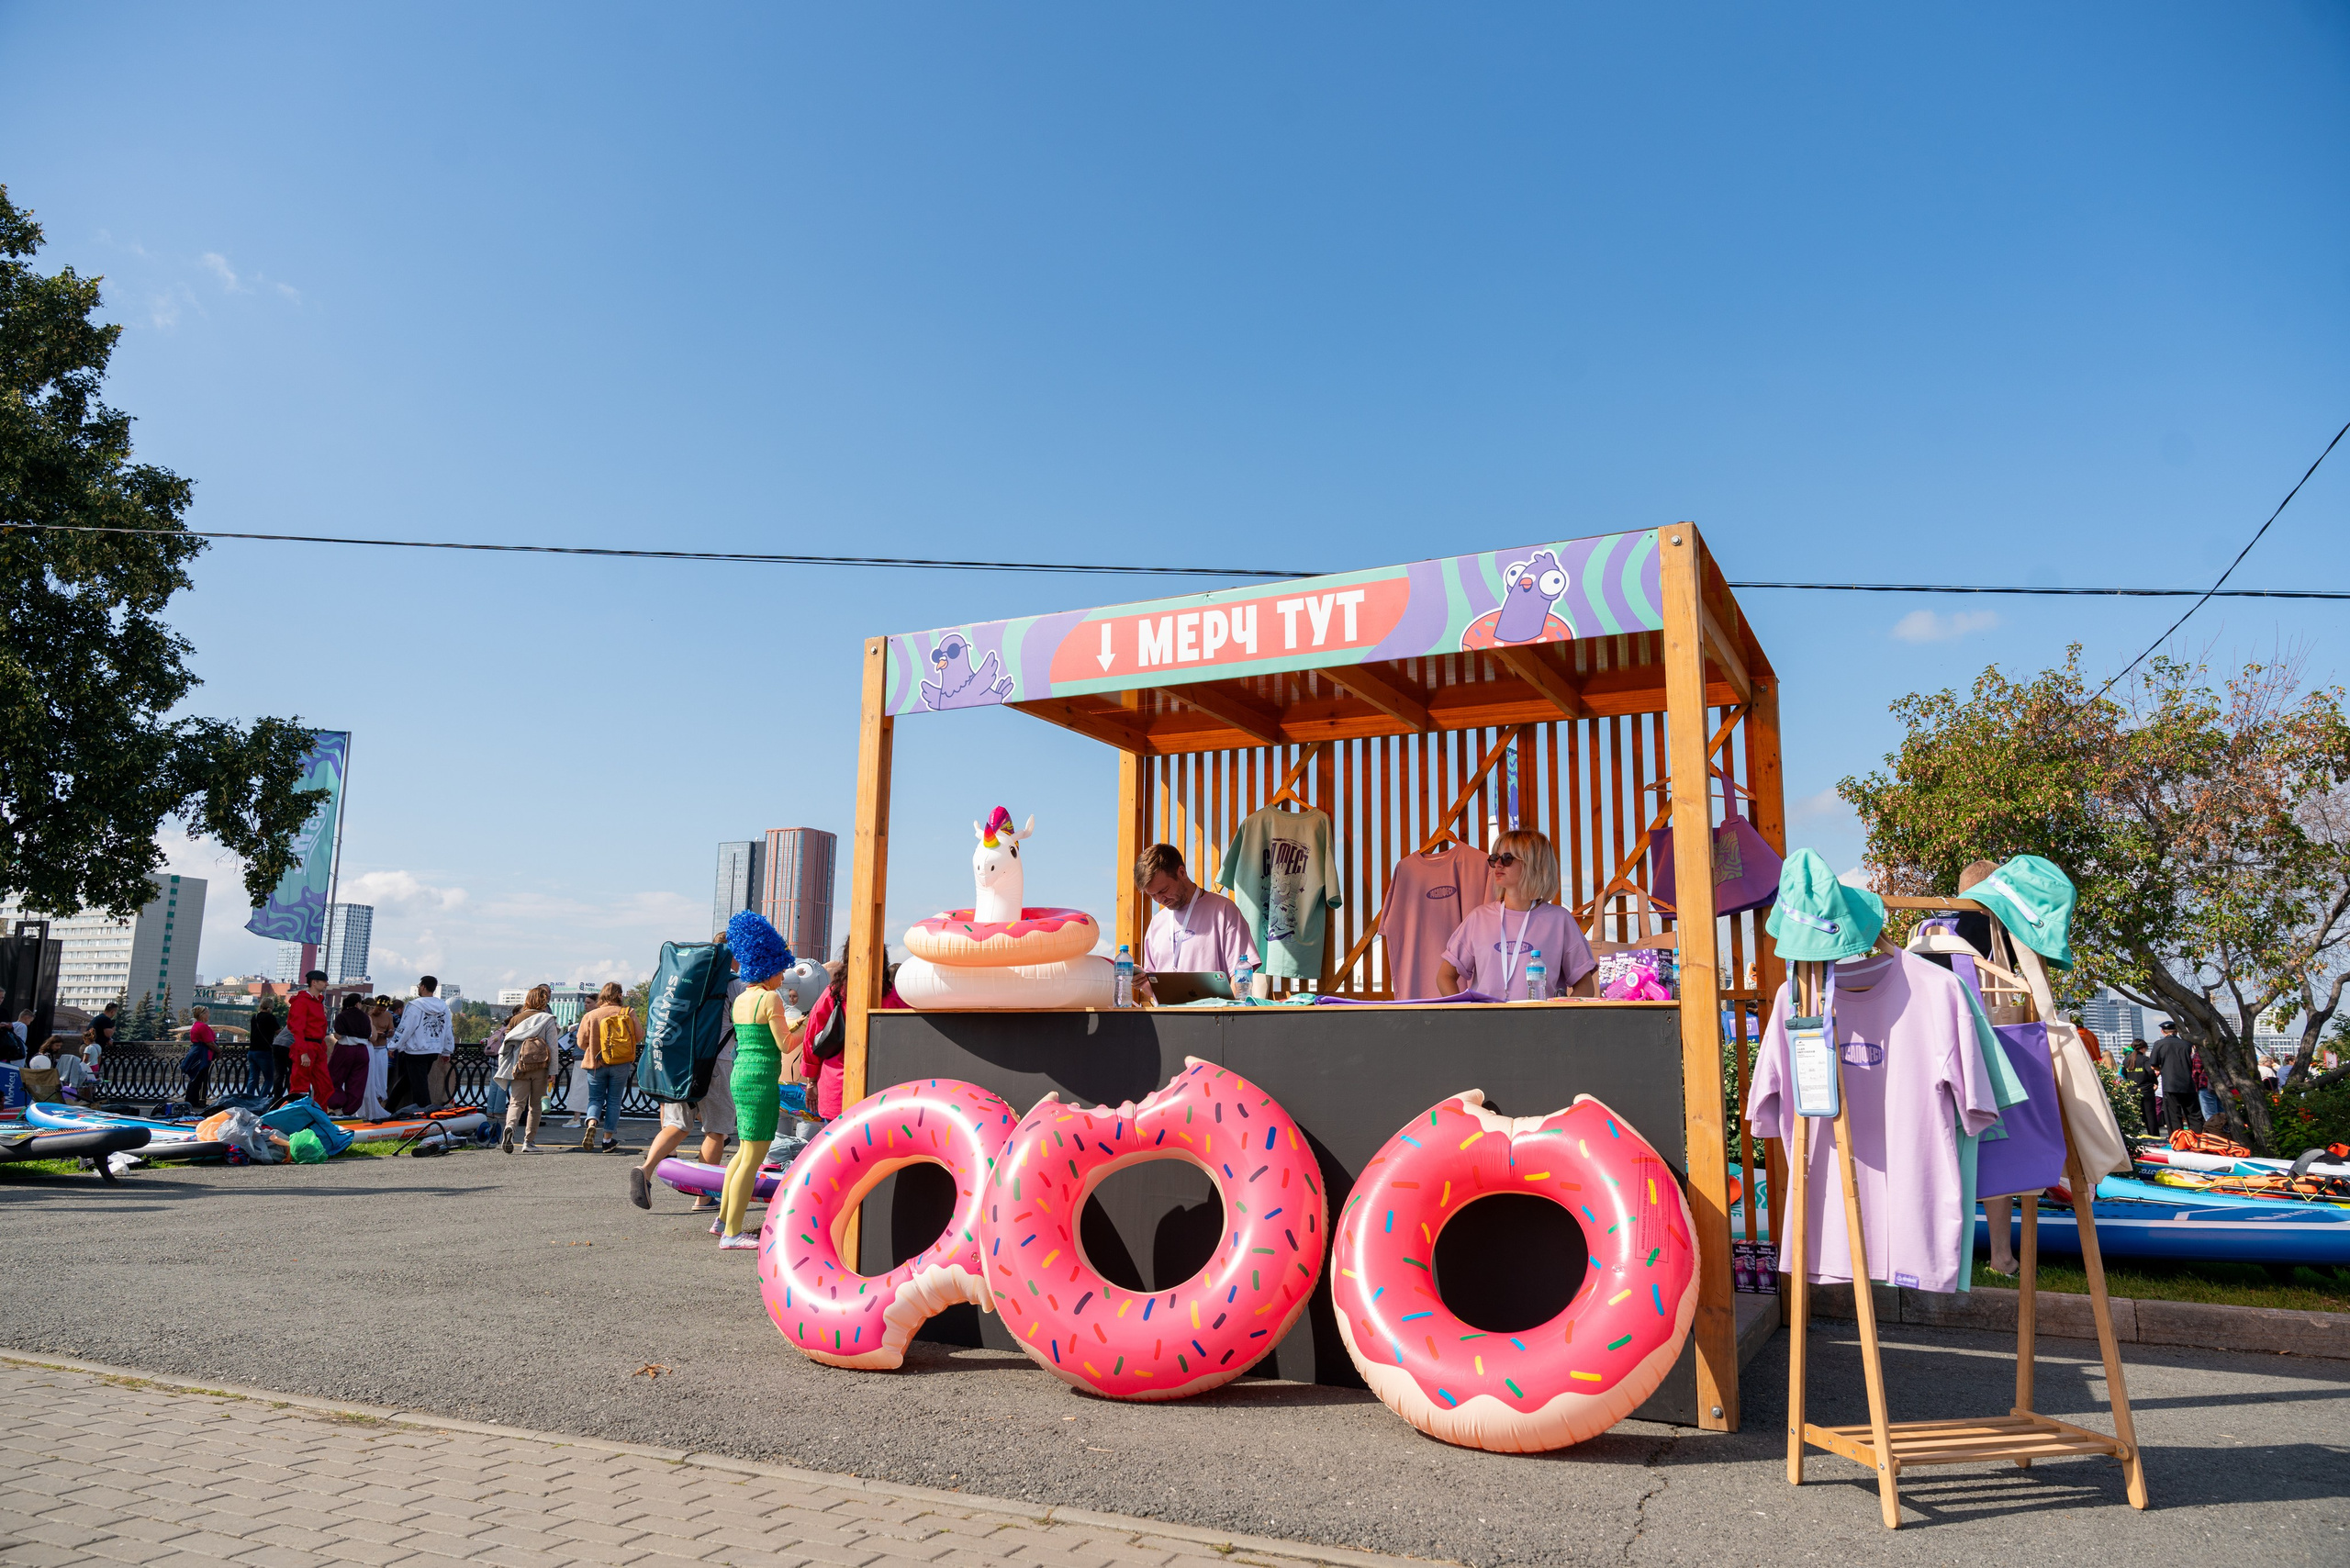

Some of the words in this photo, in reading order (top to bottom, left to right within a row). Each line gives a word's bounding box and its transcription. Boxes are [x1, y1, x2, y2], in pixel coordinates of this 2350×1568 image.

[1137, 604, 1258, 667] МЕРЧ
[1277, 589, 1365, 650] ТУТ
[652, 975, 678, 1071] SKATINGER
[4, 1071, 18, 1105] Monkey
